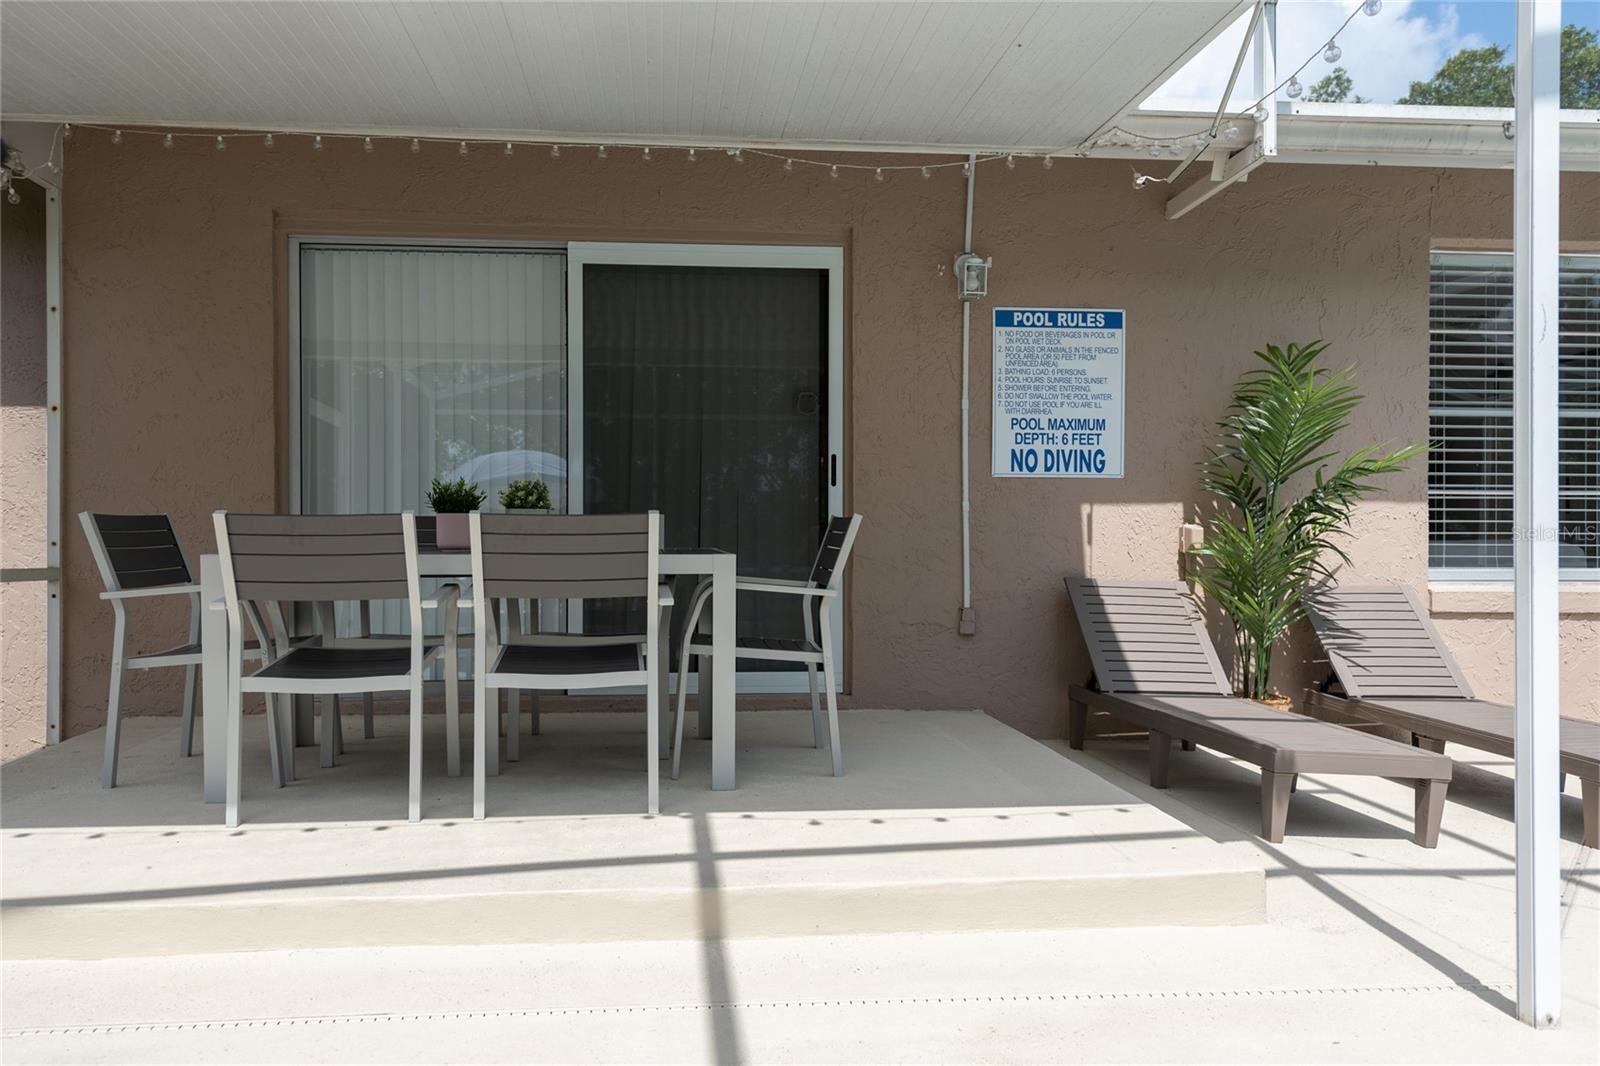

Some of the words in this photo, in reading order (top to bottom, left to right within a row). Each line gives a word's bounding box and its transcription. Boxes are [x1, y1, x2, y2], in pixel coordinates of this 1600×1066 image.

[1014, 312, 1053, 326] POOL
[1058, 312, 1105, 327] RULES
[1011, 418, 1044, 430] POOL
[1048, 418, 1106, 431] MAXIMUM
[1015, 433, 1058, 445] DEPTH:
[1062, 433, 1068, 445] 6
[1072, 433, 1102, 445] FEET
[1011, 449, 1038, 472] NO
[1044, 449, 1105, 473] DIVING
